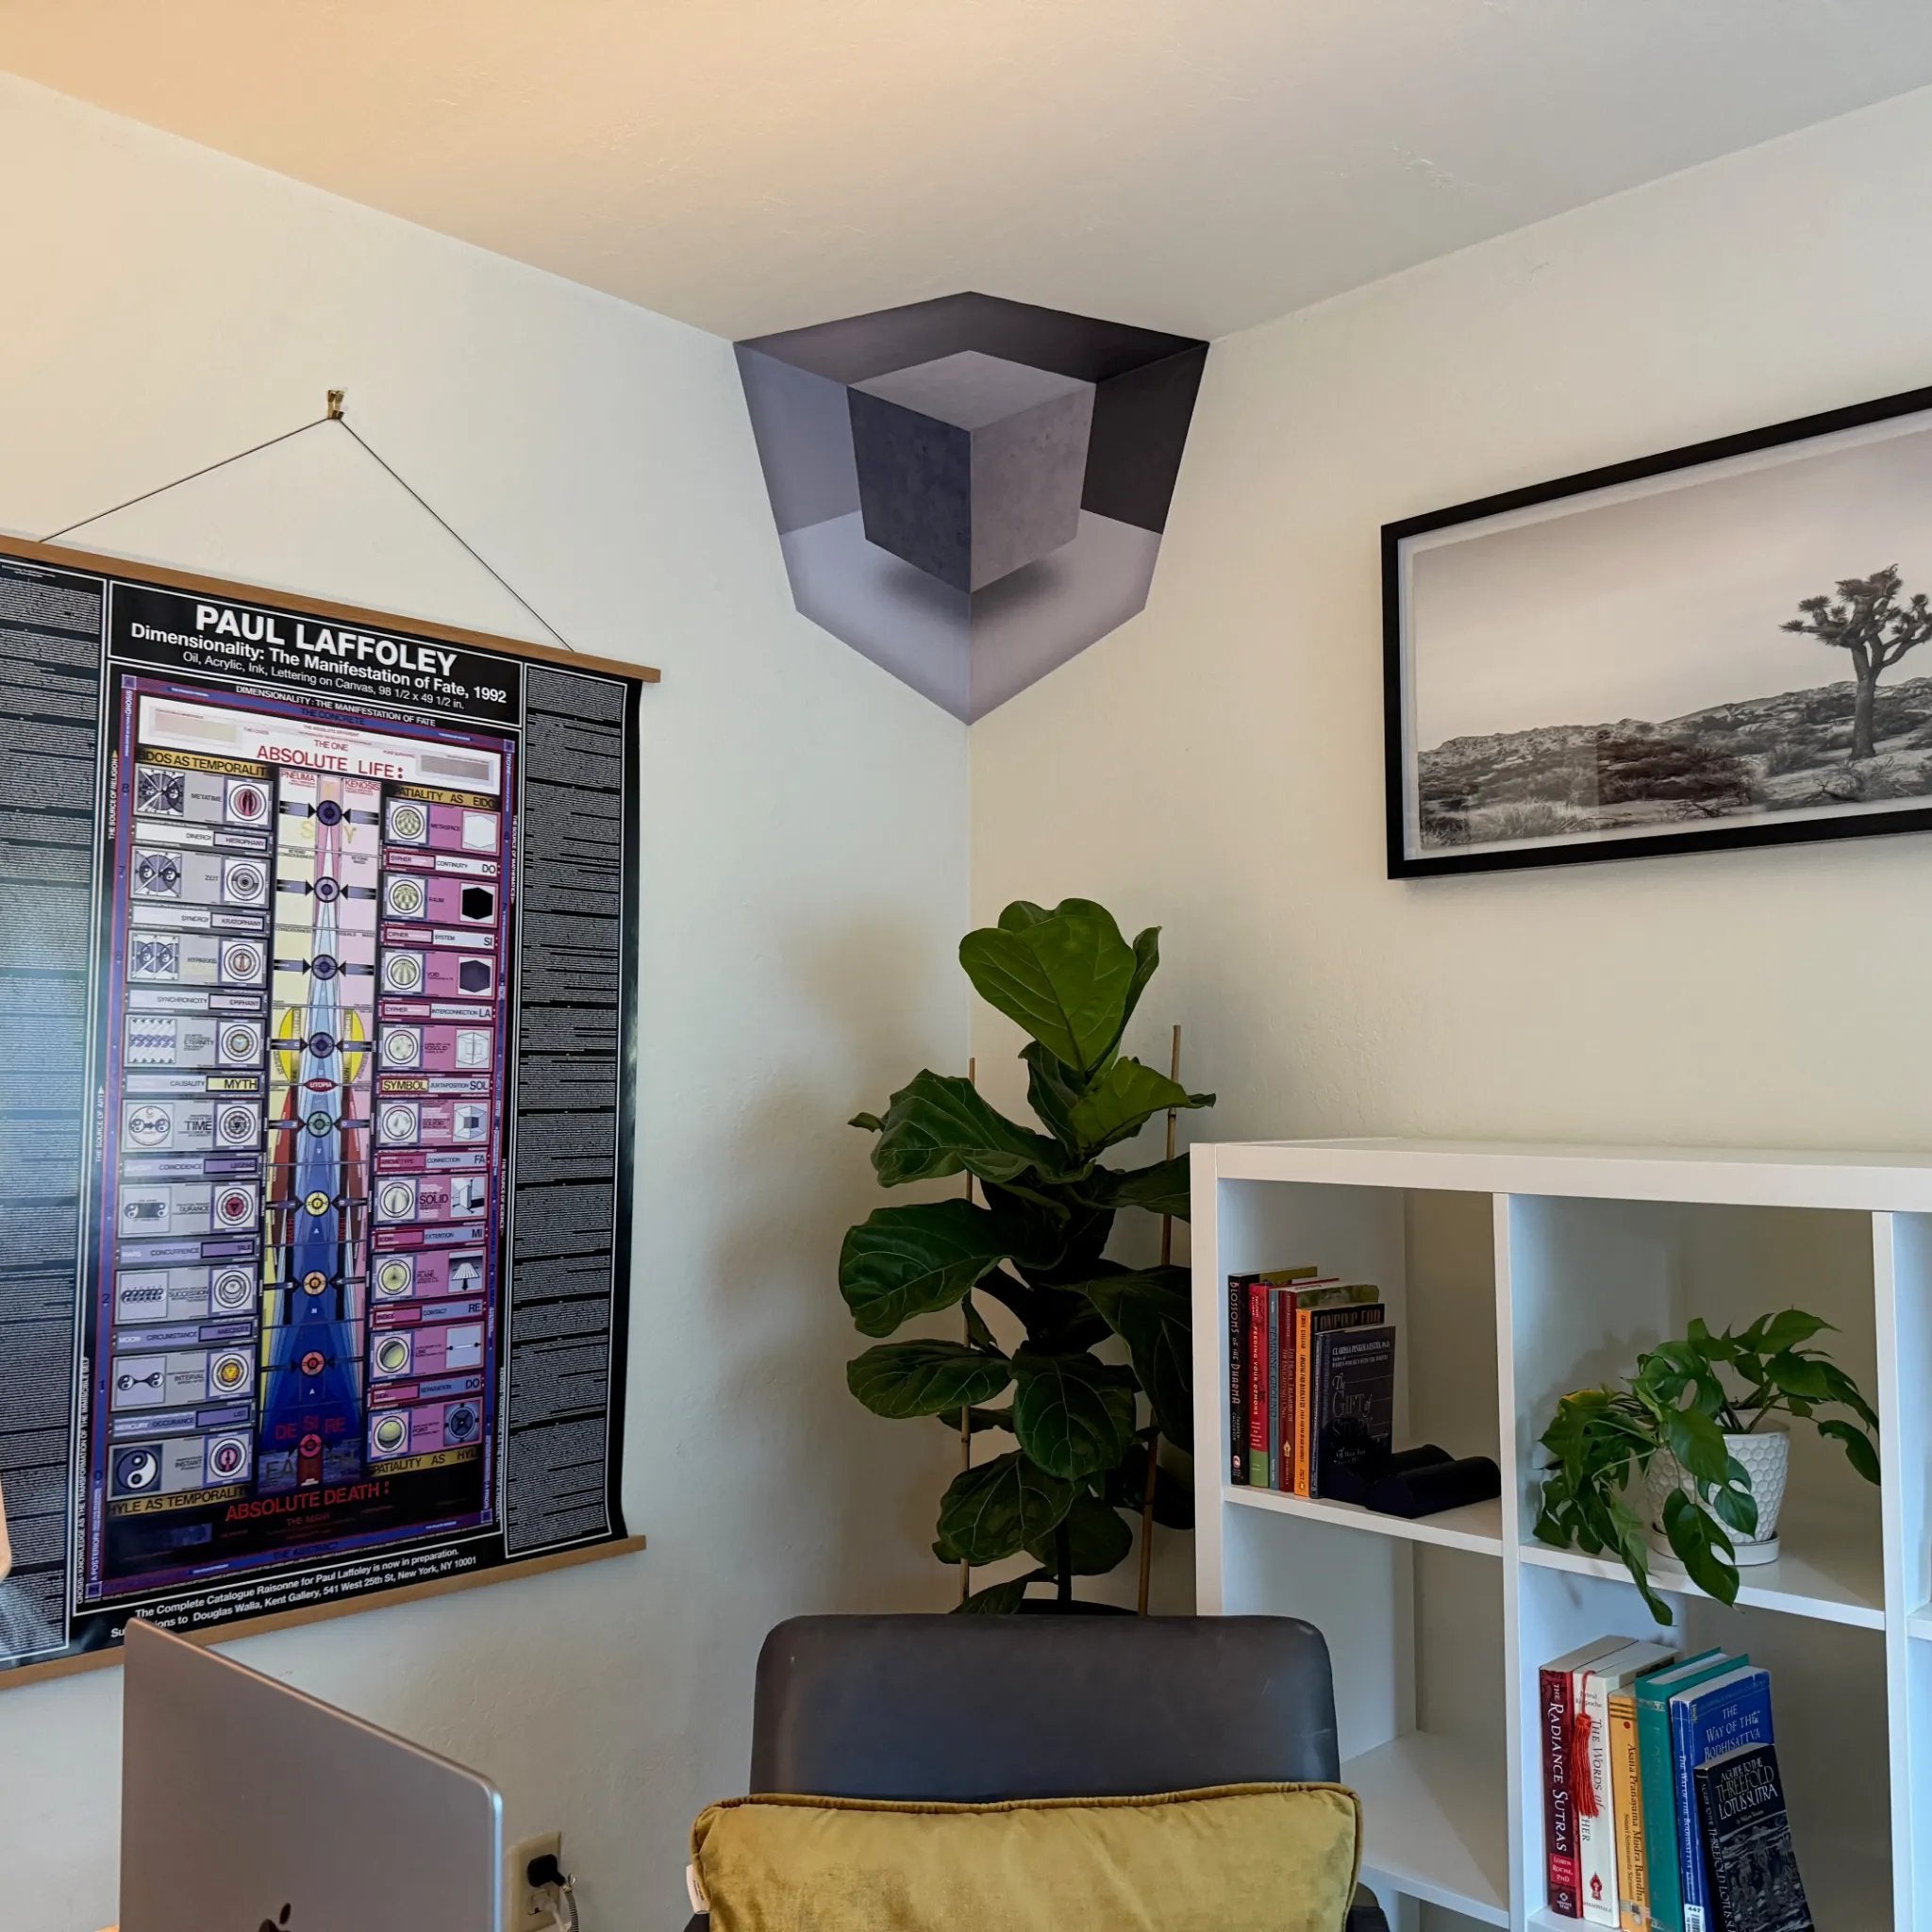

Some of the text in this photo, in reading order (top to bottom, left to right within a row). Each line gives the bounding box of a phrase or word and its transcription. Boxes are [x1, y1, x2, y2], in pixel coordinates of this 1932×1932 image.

[195, 604, 458, 676] PAUL LAFFOLEY
[130, 622, 508, 704] Dimensionality: The Manifestation of Fate, 1992
[182, 651, 202, 666] Oil,
[204, 656, 245, 673] Acrylic,
[248, 662, 268, 675] Ink,
[271, 666, 317, 686] Lettering
[319, 676, 333, 687] on
[335, 677, 376, 695] Canvas,
[378, 686, 391, 696] 98
[394, 688, 409, 700] 1/2
[421, 692, 434, 704] 49
[436, 695, 451, 708] 1/2
[453, 698, 464, 709] in.
[315, 700, 333, 709] THE
[335, 703, 401, 721] MANIFESTATION
[403, 713, 414, 724] OF
[416, 716, 436, 727] FATE
[257, 744, 348, 772] ABSOLUTE
[314, 740, 349, 752] THE ONE
[174, 756, 266, 776] AS TEMPORALIT
[450, 793, 464, 805] AS
[482, 863, 496, 874] DO
[483, 937, 492, 946] SI
[479, 1008, 491, 1018] LA
[224, 1079, 258, 1090] MYTH
[309, 1080, 333, 1089] UTOPIA
[383, 1080, 425, 1091] SYMBOL
[469, 1080, 489, 1091] SOL
[184, 1121, 212, 1131] TIME
[419, 1194, 449, 1205] SOLID
[472, 1229, 482, 1239] MI
[468, 1304, 482, 1313] RE
[465, 1378, 480, 1390] DO
[1231, 1363, 1241, 1405] DHARMA
[78, 1440, 87, 1502] TRANSFORMATION
[430, 1454, 446, 1465] AS
[145, 1497, 163, 1509] AS
[167, 1486, 245, 1508] TEMPORALIT
[225, 1490, 321, 1522] ABSOLUTE
[76, 1527, 85, 1573] KNOWLEDGE
[135, 1548, 459, 1619] The Complete Catalogue Raisonne for Paul Laffoley is now in preparation.
[177, 1616, 189, 1625] to
[192, 1607, 233, 1623] Douglas
[264, 1595, 287, 1607] Kent
[288, 1589, 323, 1603] Gallery,
[323, 1585, 339, 1596] 541
[341, 1580, 363, 1592] West
[363, 1577, 383, 1588] 25th
[384, 1574, 396, 1583] St,
[398, 1570, 417, 1580] New
[418, 1564, 440, 1576] York,
[441, 1561, 453, 1572] NY
[455, 1557, 476, 1569] 10001
[1722, 1704, 1738, 1720] THE
[1706, 1711, 1759, 1743] WAY OF THE
[1548, 1703, 1564, 1784] RADIANCE
[1704, 1727, 1761, 1763] BODHISATTVA
[1591, 1719, 1606, 1810] THE WORDS of
[1715, 1765, 1774, 1803] THREEFOLD
[1718, 1794, 1747, 1820] LOTUS
[1746, 1783, 1778, 1807] SUTRA
[1552, 1789, 1569, 1852] SUTRAS
[1627, 1743, 1645, 1902] Asana Pranayama Mudra Bandha
